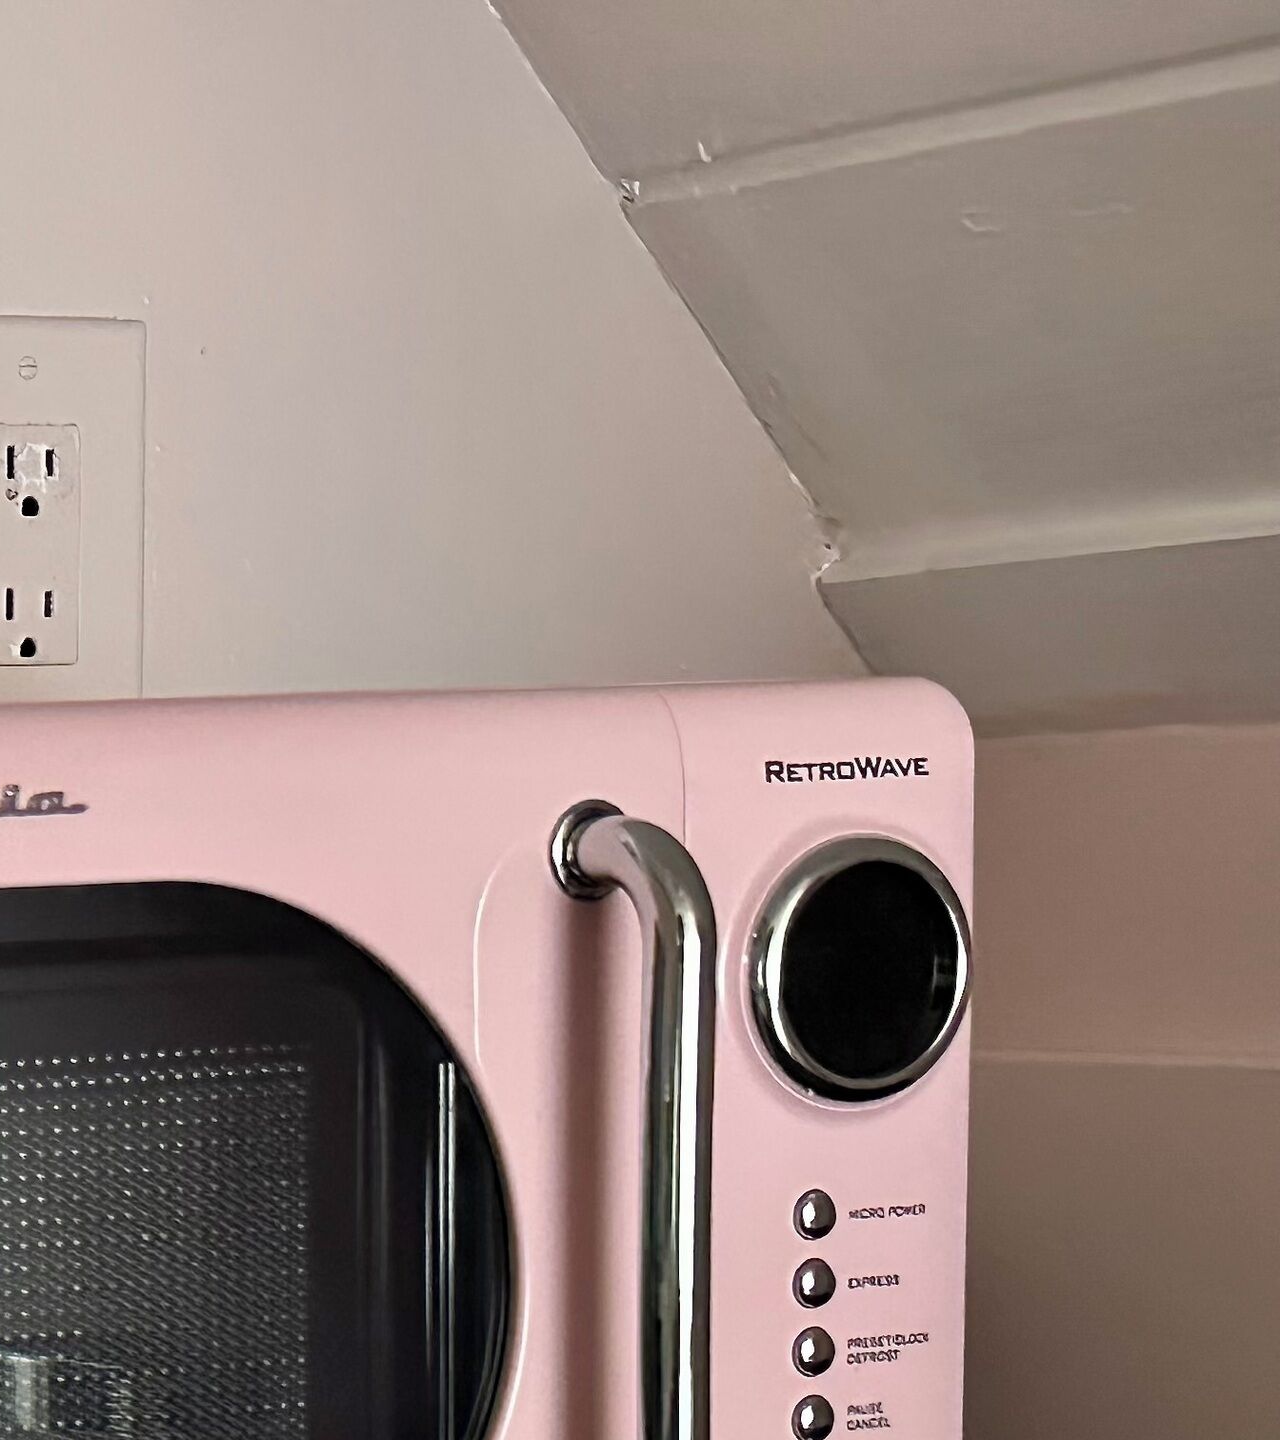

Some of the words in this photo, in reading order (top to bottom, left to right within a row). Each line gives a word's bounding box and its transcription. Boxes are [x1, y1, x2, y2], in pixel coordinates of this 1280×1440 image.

[888, 1203, 926, 1217] POWER
[847, 1273, 900, 1289] EXPRESS
[846, 1349, 901, 1365] DEFROST
